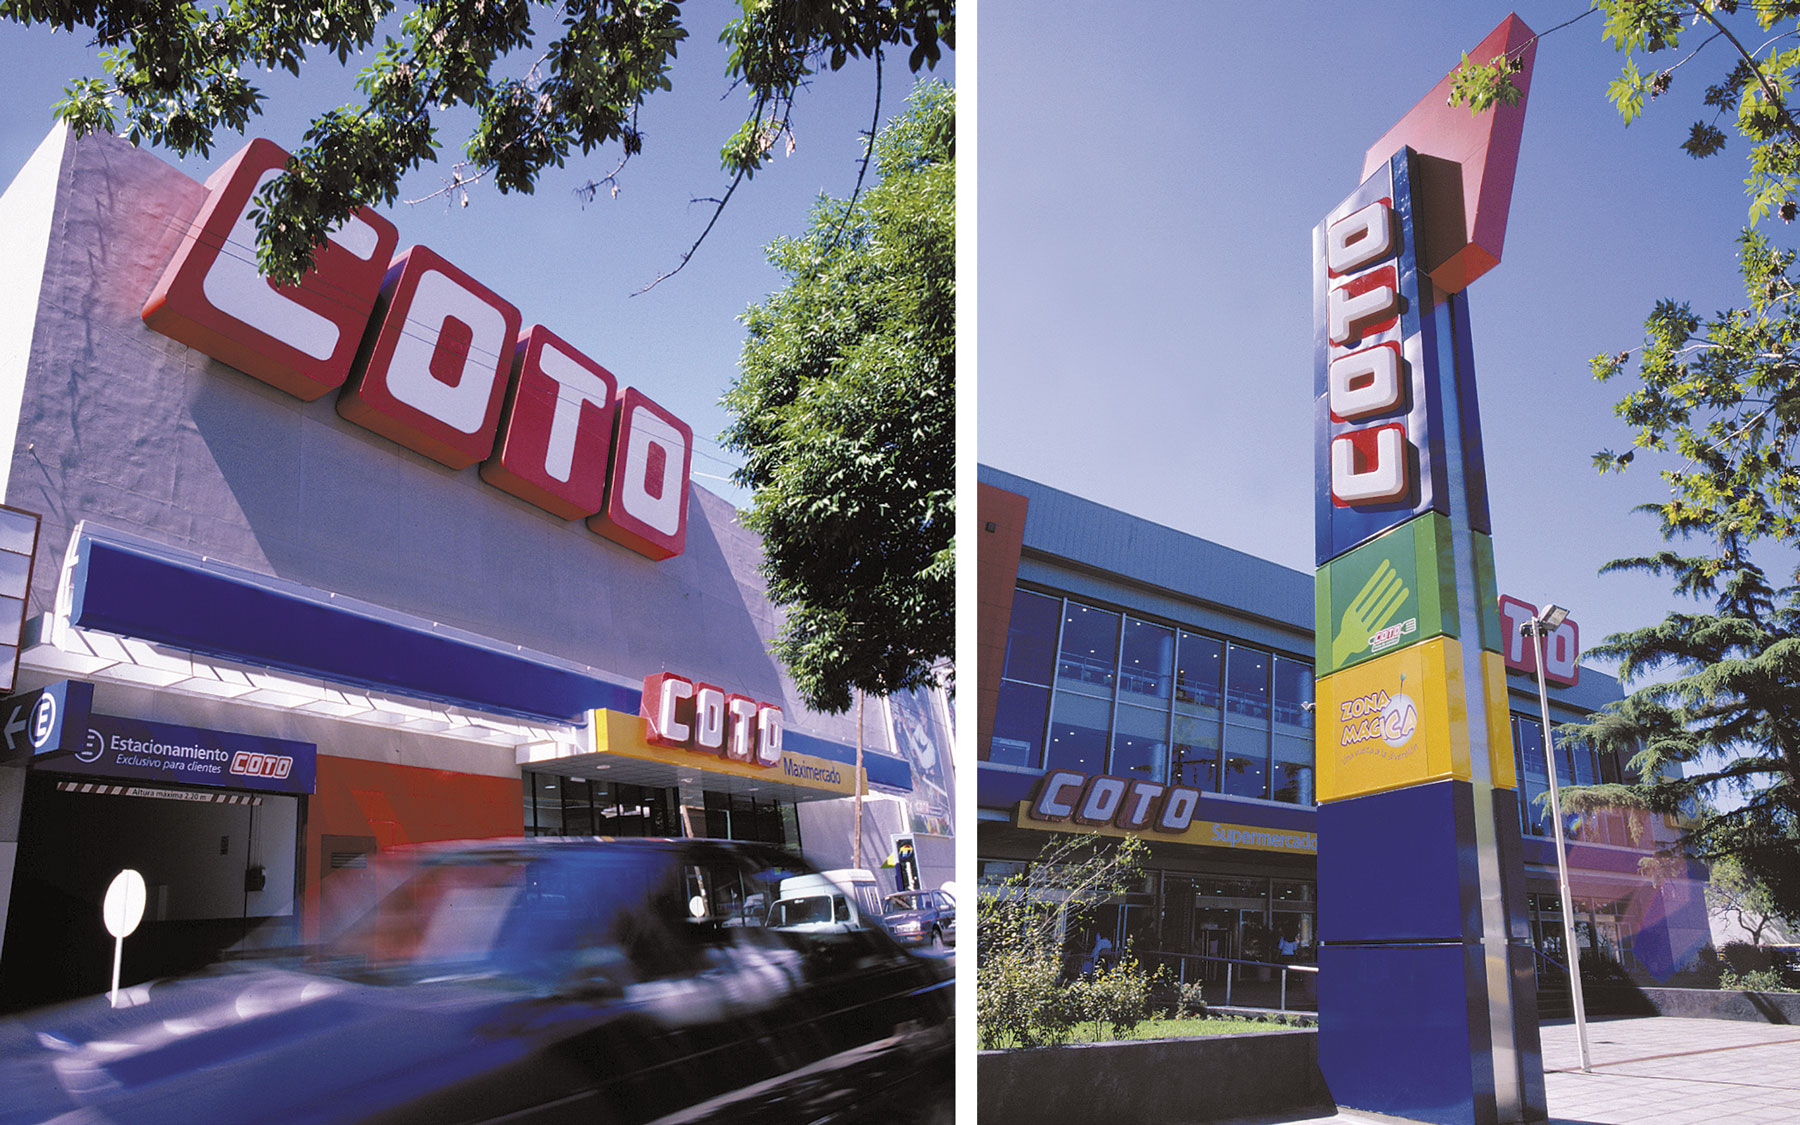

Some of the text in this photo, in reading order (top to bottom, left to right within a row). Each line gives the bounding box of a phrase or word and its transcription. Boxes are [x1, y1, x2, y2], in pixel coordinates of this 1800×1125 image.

[202, 167, 686, 537] COTO
[1329, 201, 1404, 501] COTO
[657, 677, 783, 763] COTO
[1341, 689, 1392, 722] ZONA
[110, 735, 229, 762] Estacionamiento
[116, 754, 221, 774] Exclusivo para clientes
[231, 751, 293, 778] COTO
[783, 757, 841, 784] Maximercado
[1039, 771, 1199, 829] COTO
[1212, 823, 1317, 850] Supermercado
